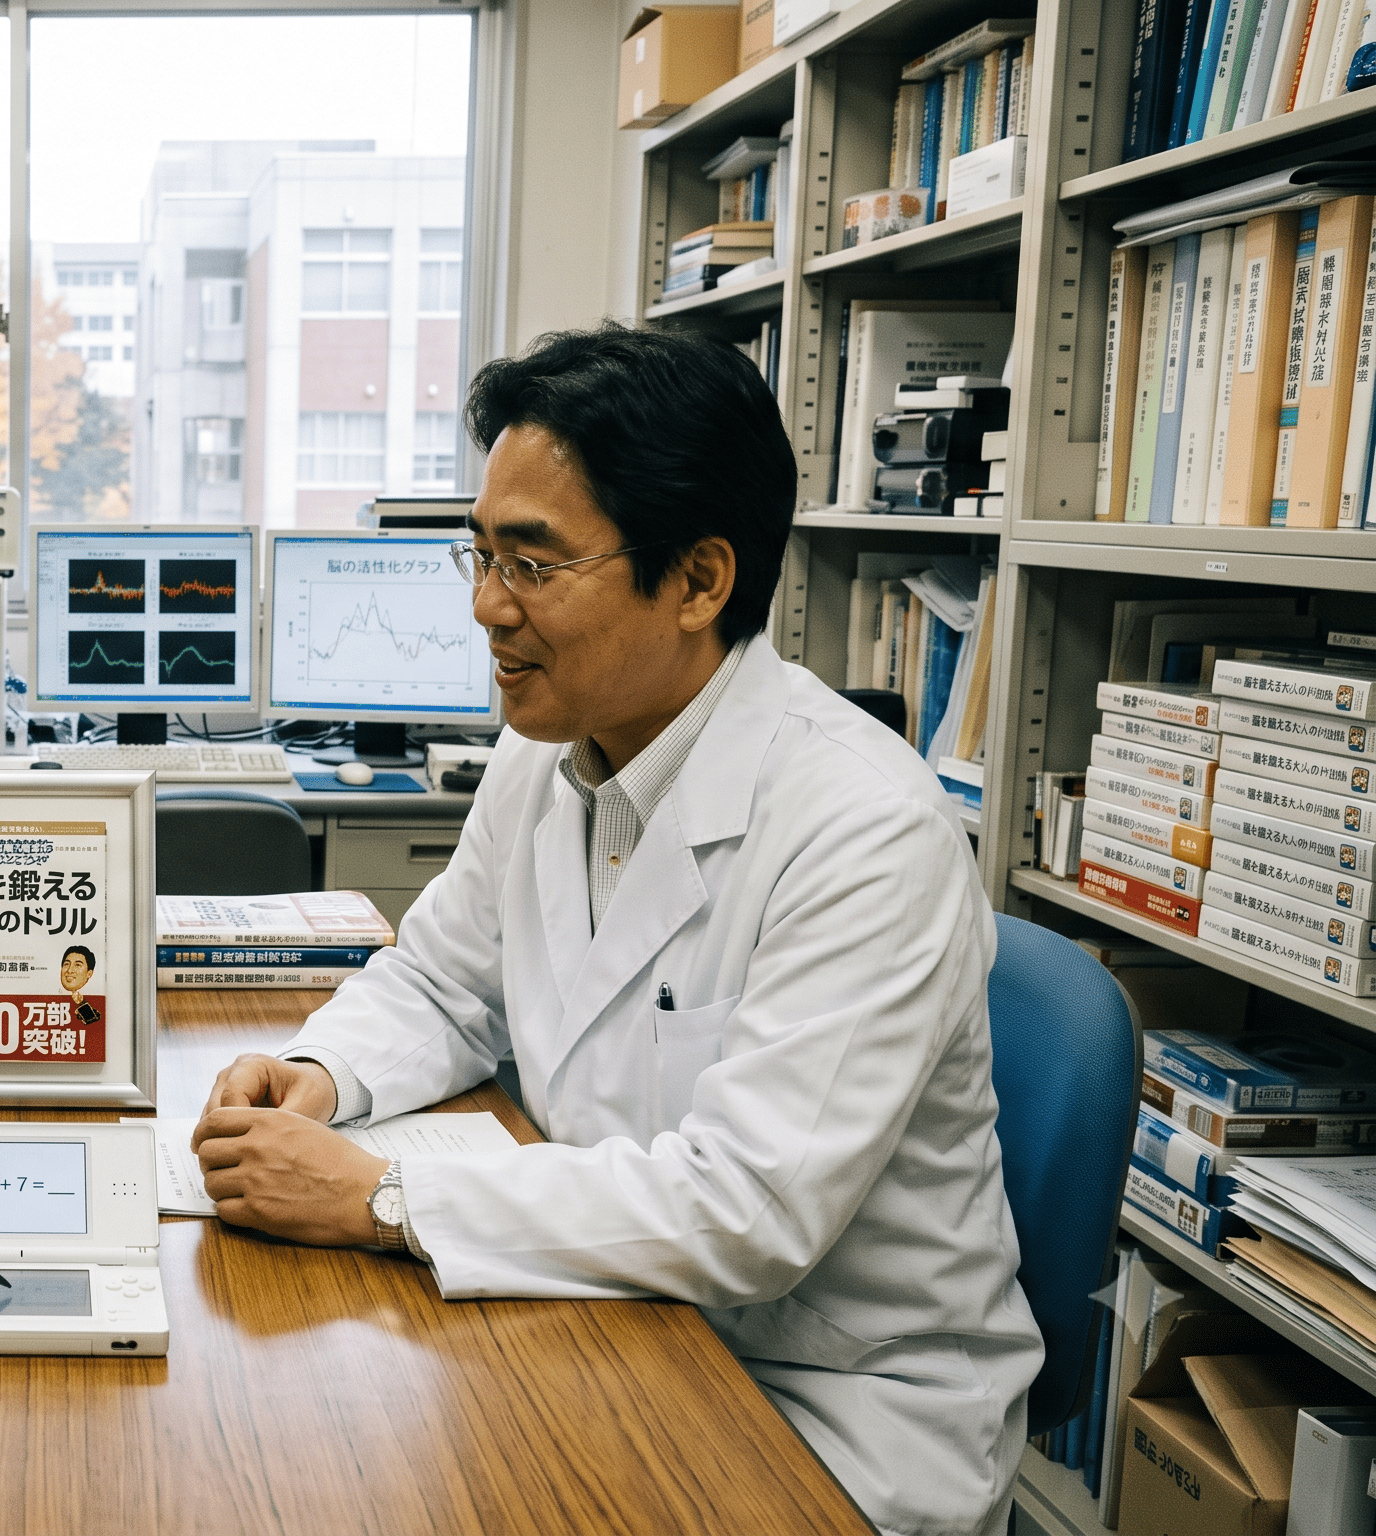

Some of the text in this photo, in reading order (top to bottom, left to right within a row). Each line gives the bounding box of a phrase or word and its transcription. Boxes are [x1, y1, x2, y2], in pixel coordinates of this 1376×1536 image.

[327, 559, 442, 574] 脳の活性化グラフ
[22, 1001, 72, 1027] 万部
[16, 1176, 28, 1192] 7
